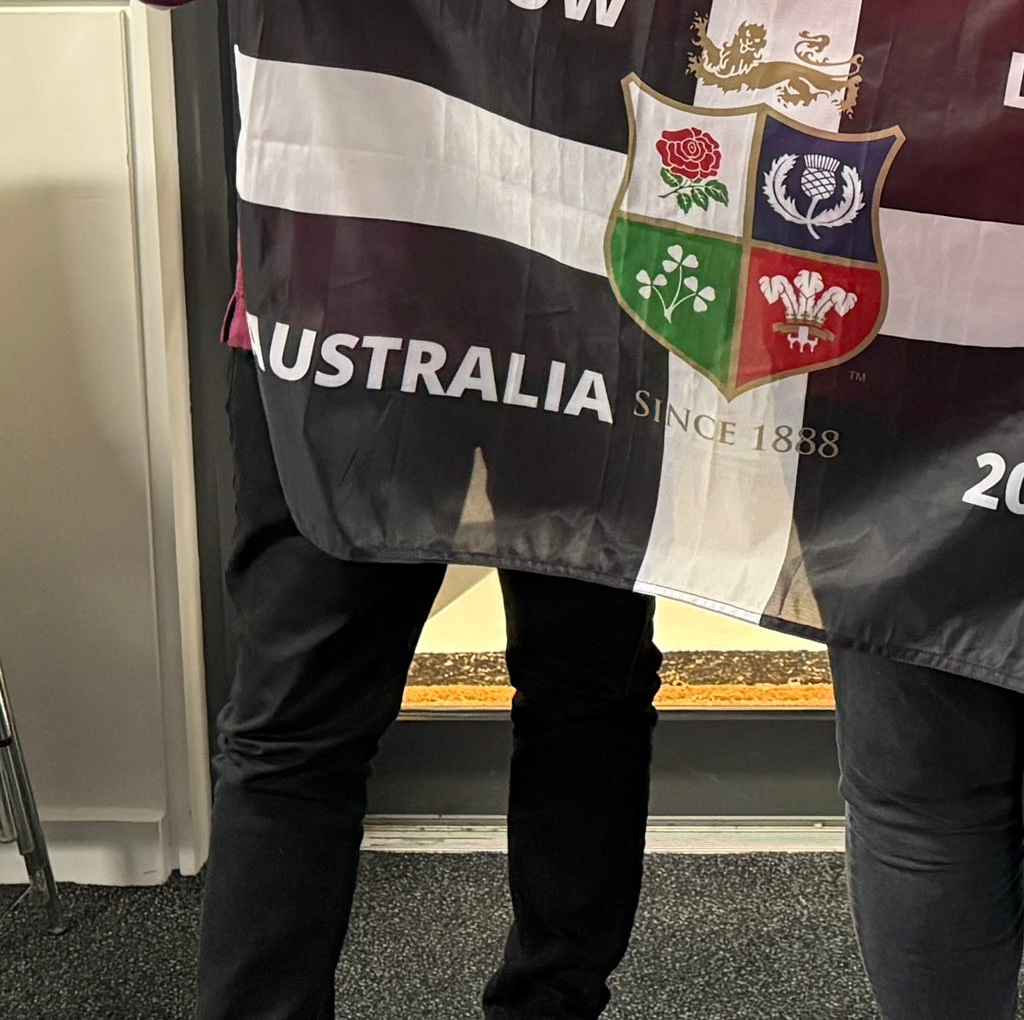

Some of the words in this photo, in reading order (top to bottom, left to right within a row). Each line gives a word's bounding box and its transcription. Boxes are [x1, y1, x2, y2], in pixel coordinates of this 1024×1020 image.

[848, 370, 867, 383] TM
[633, 389, 737, 446] SINCE
[752, 423, 840, 459] 1888
